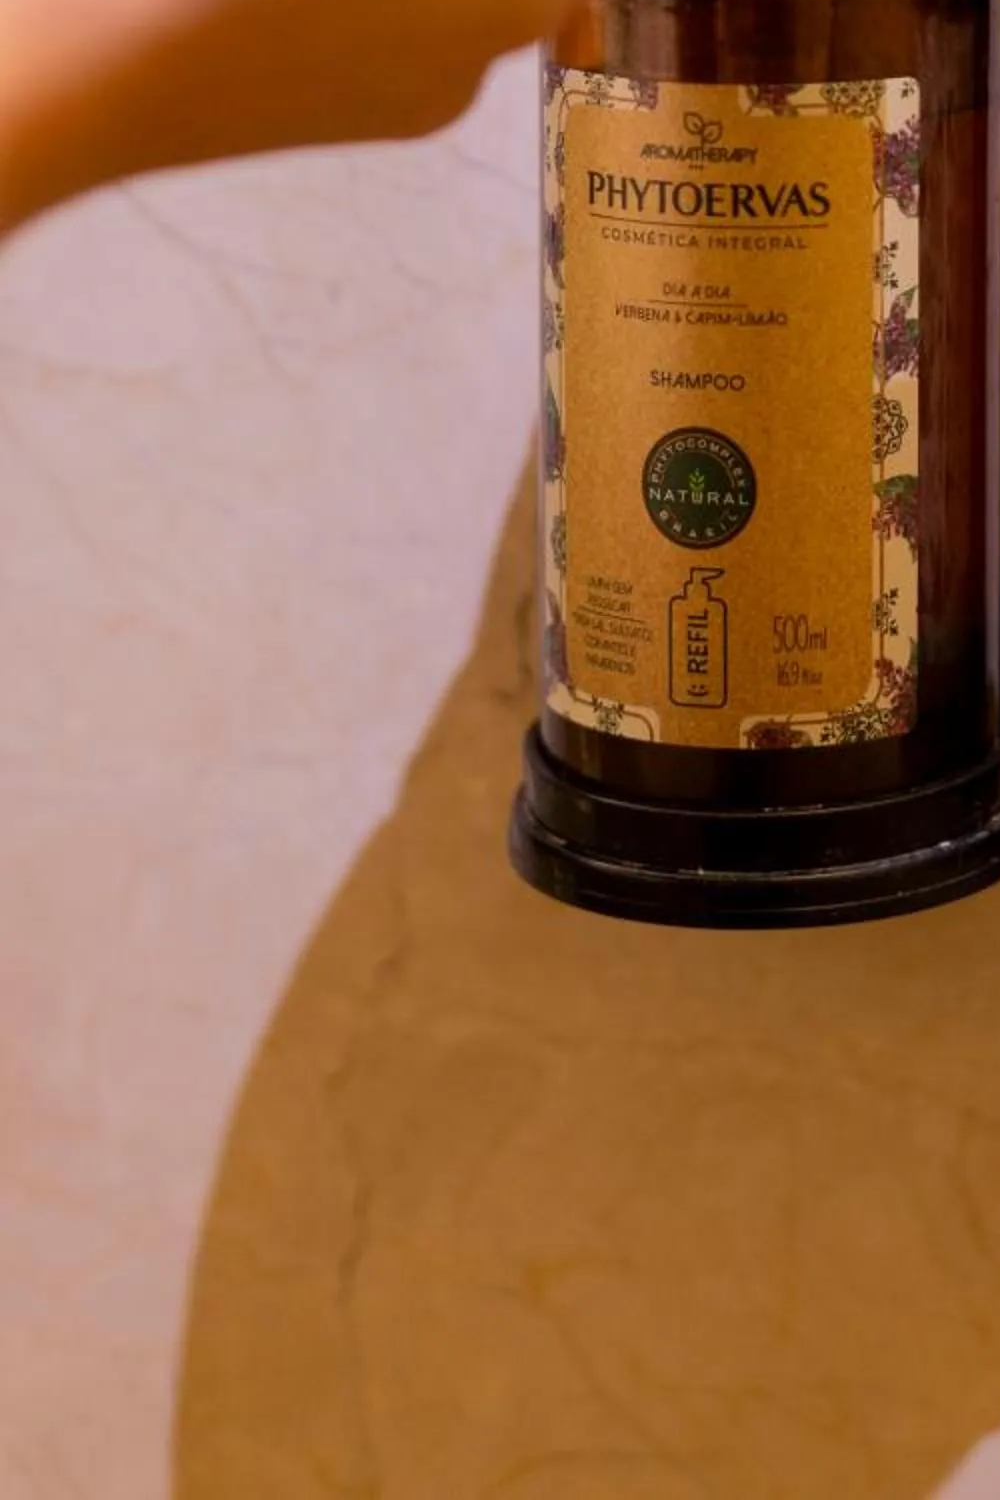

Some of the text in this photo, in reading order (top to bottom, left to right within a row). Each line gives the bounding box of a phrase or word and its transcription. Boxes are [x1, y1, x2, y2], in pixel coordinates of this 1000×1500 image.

[587, 171, 831, 218] PHYTOERVAS
[708, 236, 807, 251] INTEGRAL
[662, 282, 731, 299] DIA A DIA
[615, 304, 670, 322] VERBENA
[650, 368, 746, 392] SHAMPOO
[649, 487, 749, 506] NATURAL
[687, 608, 710, 676] REFIL
[772, 613, 828, 655] 500ml
